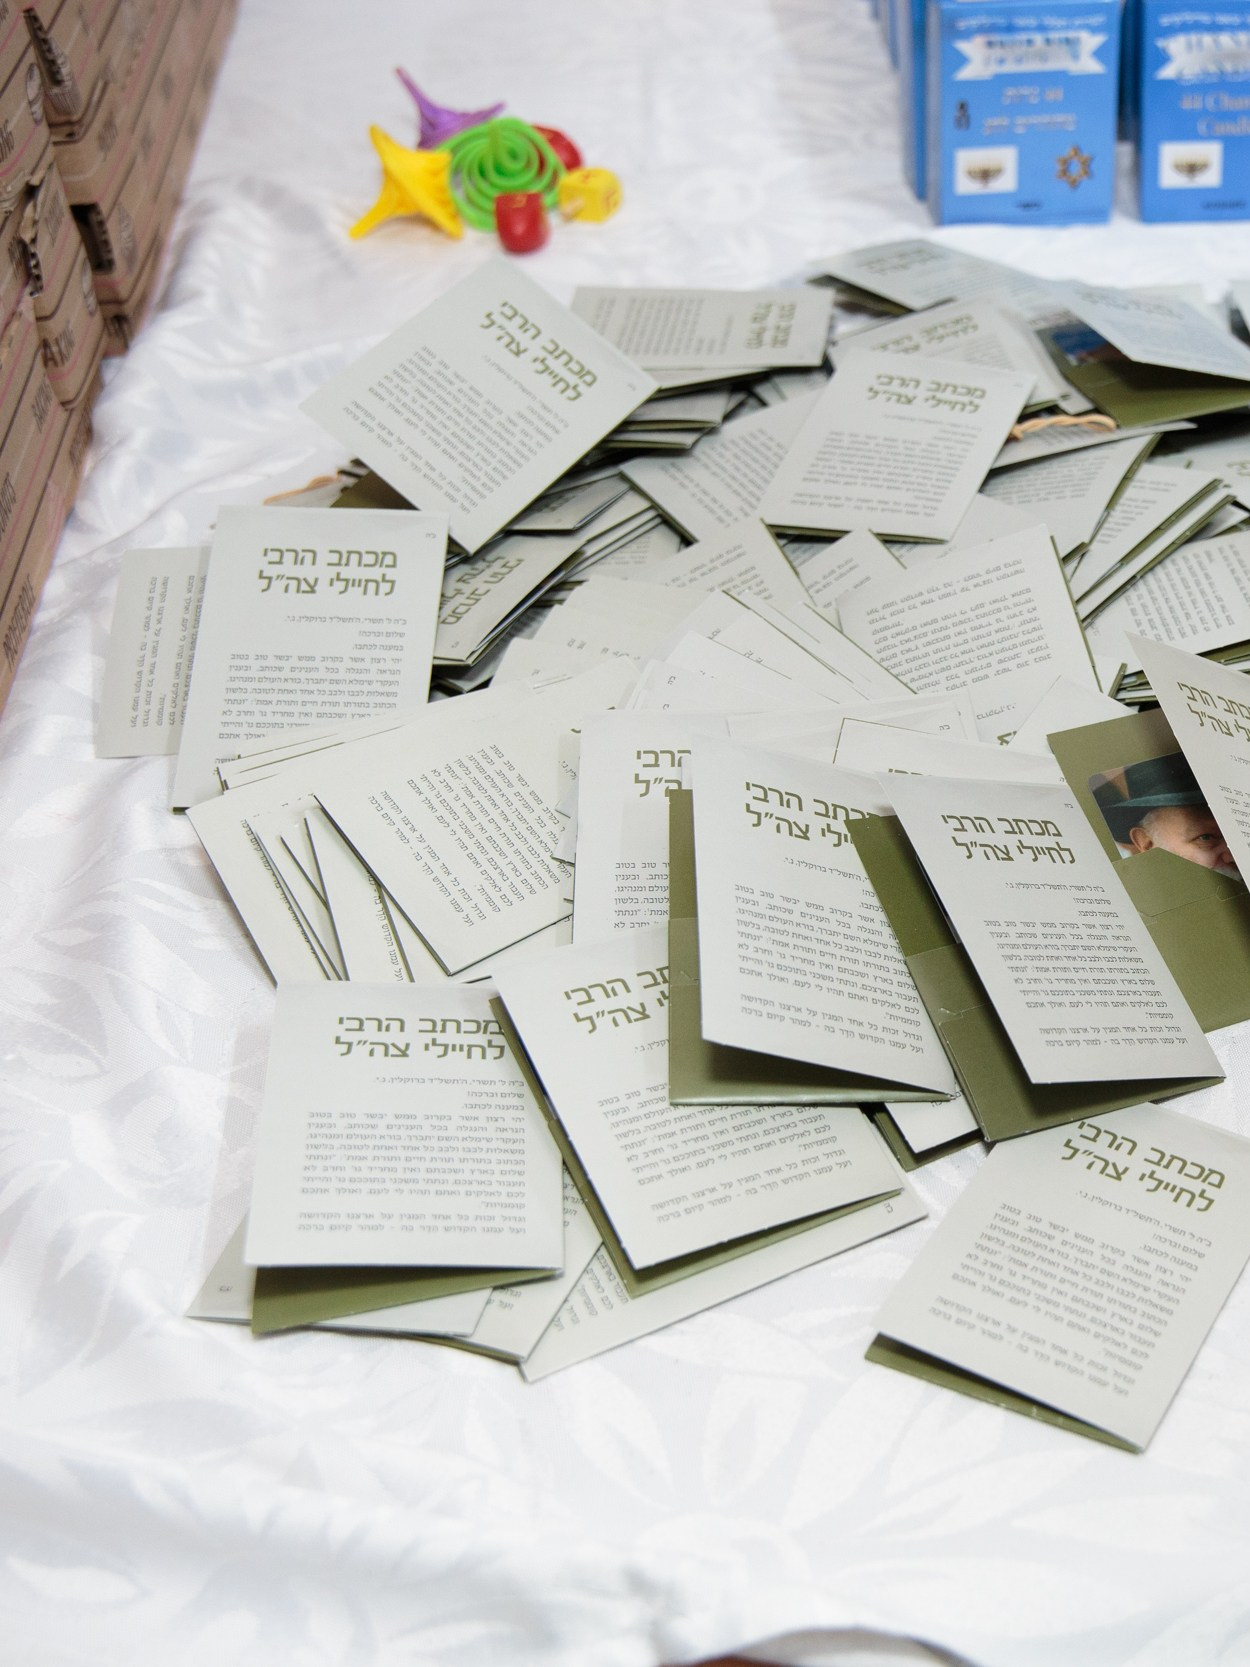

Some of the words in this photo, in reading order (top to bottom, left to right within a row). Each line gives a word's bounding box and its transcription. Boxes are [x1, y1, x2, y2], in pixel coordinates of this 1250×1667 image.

[500, 301, 542, 338] הרבי
[480, 312, 528, 357] צה"ל
[541, 339, 598, 388] מכתב
[532, 356, 582, 401] לחיילי
[873, 374, 921, 392] הרבי
[868, 383, 919, 405] צה"ל
[924, 380, 986, 402] מכתב
[924, 395, 984, 414] לחיילי
[263, 548, 317, 566] הרבי
[326, 549, 397, 568] מכתב
[456, 556, 505, 584] צה"ל
[258, 569, 319, 594] צה"ל
[329, 572, 396, 596] לחיילי
[438, 588, 491, 625] מכתב
[484, 558, 525, 584] הרבי
[1176, 682, 1218, 708] הרבי
[1187, 702, 1234, 738] צה"ל
[406, 779, 423, 796] אתכם
[438, 778, 453, 793] וחרב
[634, 773, 682, 798] ה"ל
[745, 781, 804, 812] הרבי
[368, 795, 383, 811] ברכה
[380, 790, 402, 814] הקדושה
[421, 796, 437, 813] ואולך
[460, 802, 477, 821] מחריד
[813, 798, 872, 821] כתב
[381, 812, 395, 826] קיום
[400, 815, 417, 833] ארצנו
[474, 821, 487, 834] ואין
[745, 802, 810, 841] צה"ל
[941, 814, 996, 834] הרבי
[997, 817, 1063, 838] מכתב
[395, 827, 409, 843] למהר
[454, 837, 468, 851] תהיו
[820, 826, 853, 848] ילי
[422, 844, 440, 862] המגין
[485, 835, 508, 859] ושכבתם
[951, 836, 1014, 862] צה"ל
[1017, 839, 1076, 864] לחיילי
[466, 851, 482, 868] ואתם
[505, 860, 522, 877] בארץ
[432, 875, 451, 897] הקדוש
[480, 869, 501, 892] לאלקים
[520, 878, 536, 894] שלום
[449, 897, 464, 912] עמנו
[457, 887, 472, 902] זכות
[470, 902, 486, 920] וגדול
[636, 964, 669, 990] תב
[564, 978, 632, 1006] הרבי
[338, 1016, 405, 1032] הרבי
[418, 1015, 506, 1036] מכתב
[573, 1002, 651, 1034] צה"ל
[334, 1036, 410, 1058] צה"ל
[424, 1036, 508, 1060] לחיילי
[1077, 1118, 1138, 1156] הרבי
[1061, 1138, 1130, 1182] צה"ל
[1144, 1147, 1225, 1189] מכתב
[1138, 1170, 1215, 1212] לחיילי
[1181, 1245, 1205, 1258] שלום
[1169, 1255, 1198, 1271] במענה
